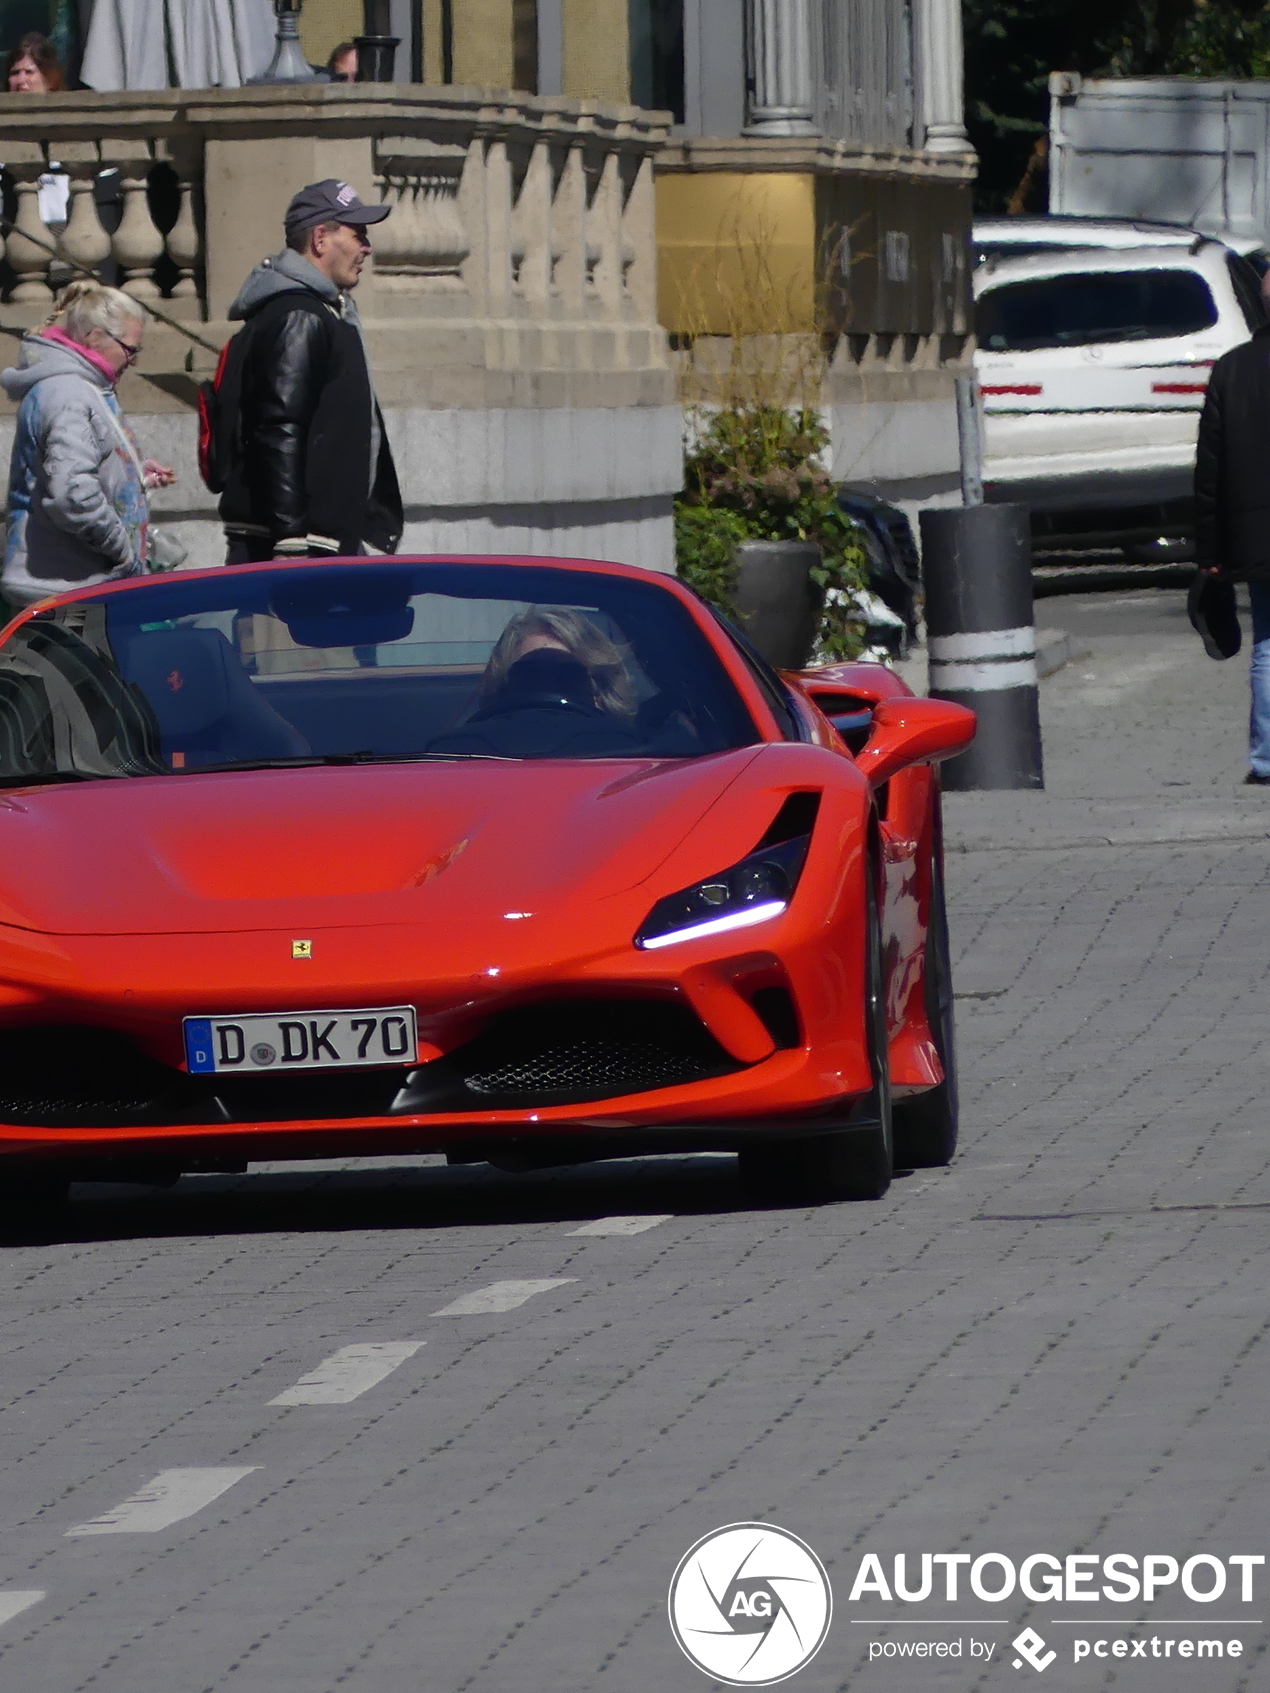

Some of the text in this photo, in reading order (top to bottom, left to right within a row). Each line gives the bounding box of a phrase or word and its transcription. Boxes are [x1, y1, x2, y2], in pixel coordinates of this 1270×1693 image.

[216, 1015, 409, 1065] D DK 70
[196, 1051, 206, 1063] D
